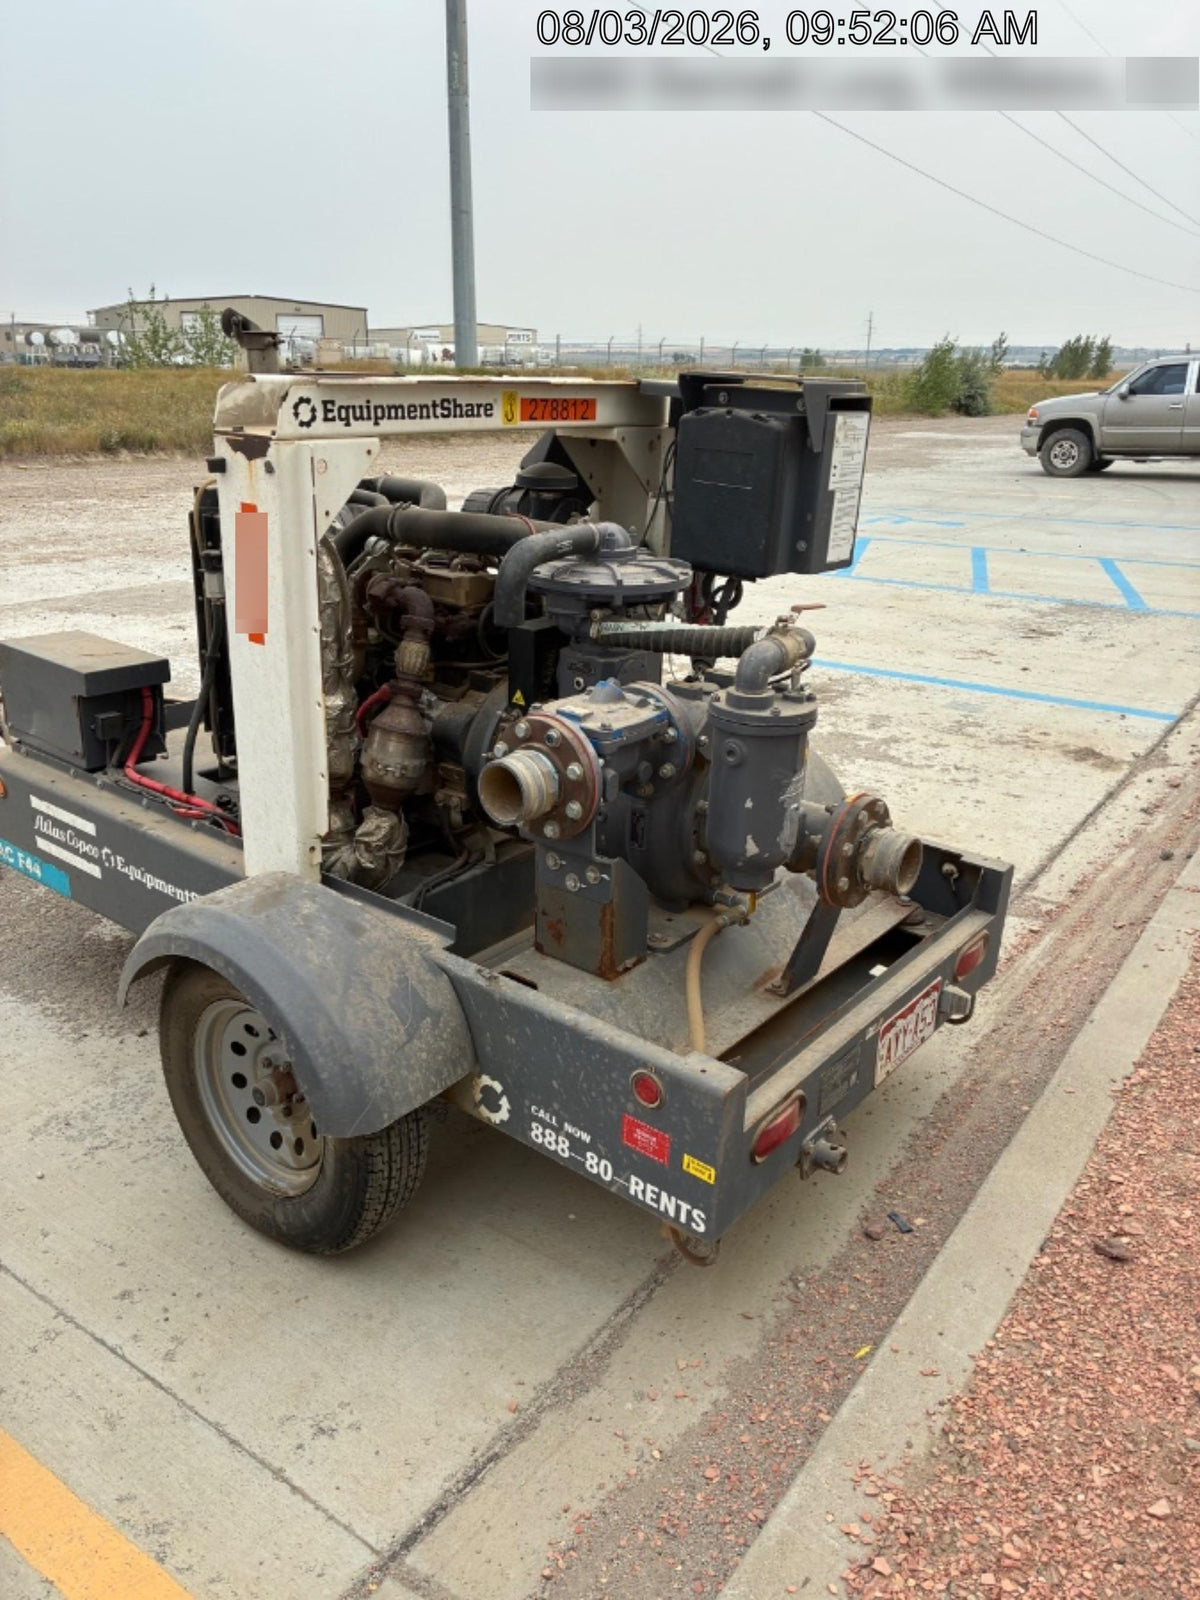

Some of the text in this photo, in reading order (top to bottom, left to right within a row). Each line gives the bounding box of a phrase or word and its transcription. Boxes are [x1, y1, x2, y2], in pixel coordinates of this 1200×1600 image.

[321, 398, 494, 427] EquipmentShare
[529, 399, 590, 421] 278812
[34, 815, 100, 859] Atlas Copco
[531, 1105, 591, 1144] CALL NOW
